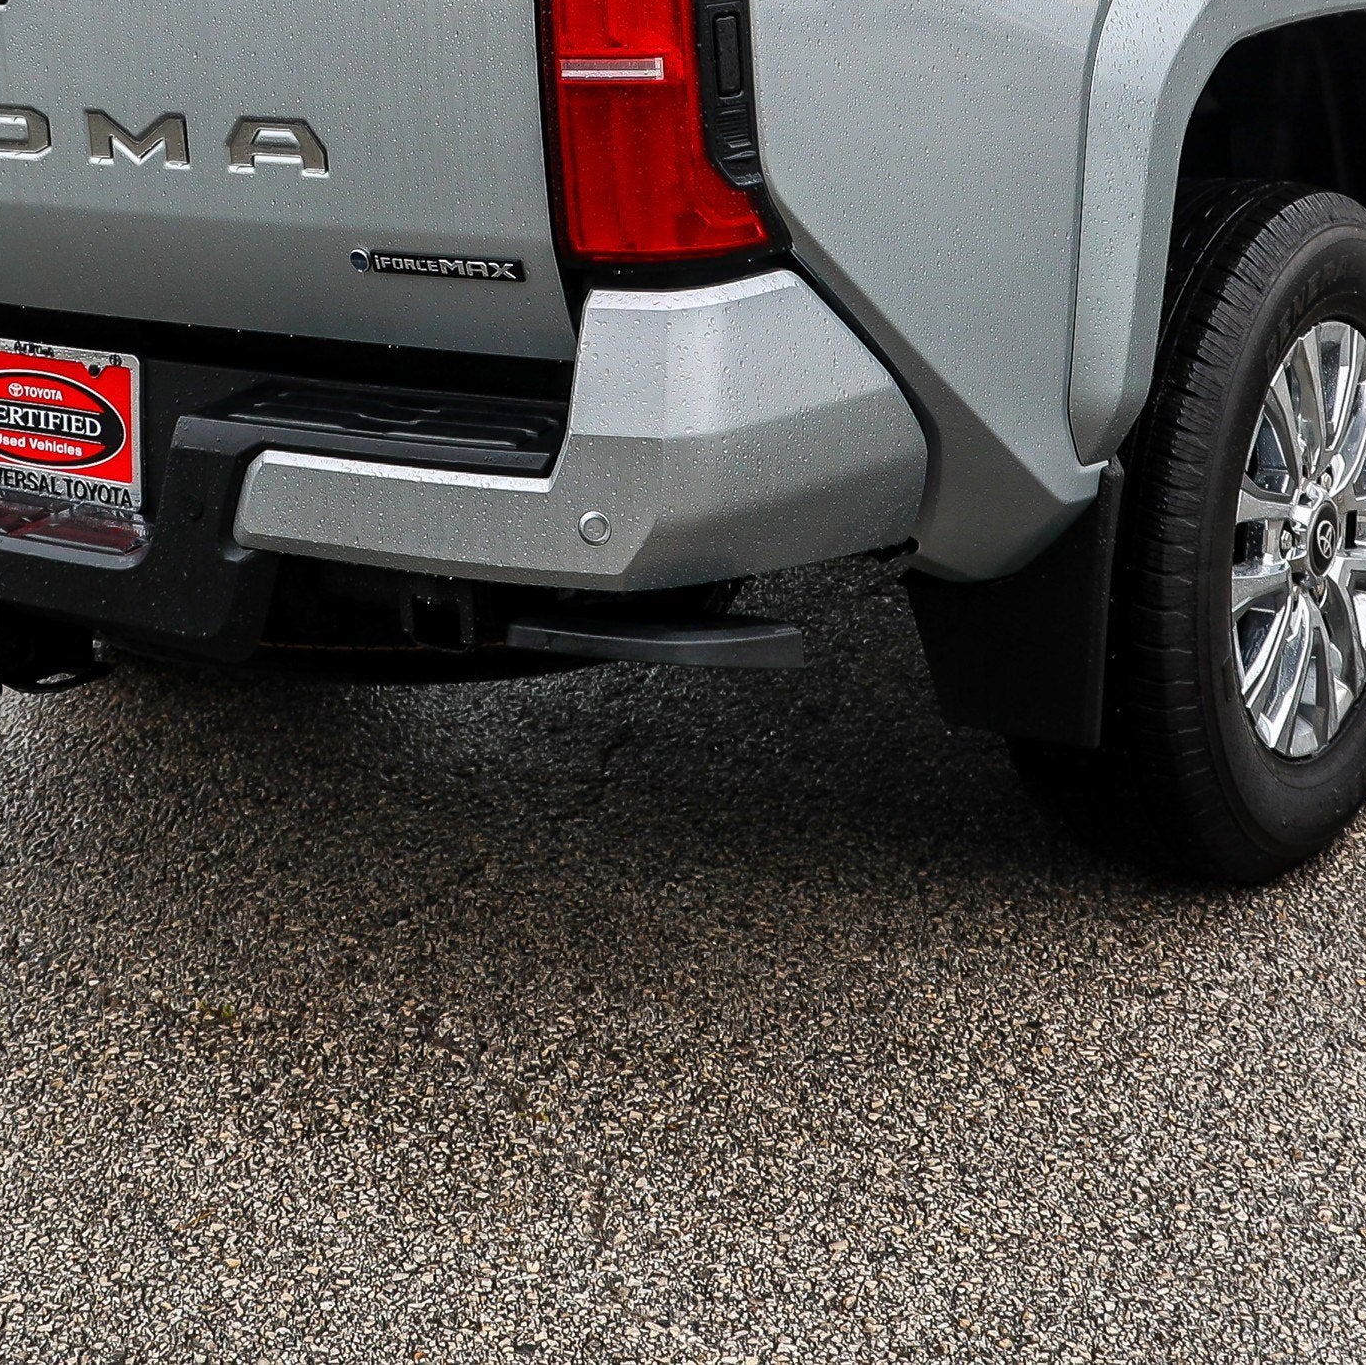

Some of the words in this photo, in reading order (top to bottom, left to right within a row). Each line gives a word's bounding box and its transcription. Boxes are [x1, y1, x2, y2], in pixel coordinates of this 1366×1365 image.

[23, 385, 64, 402] TOYOTA
[28, 437, 83, 457] Vehicles
[65, 478, 134, 508] TOYOTA
